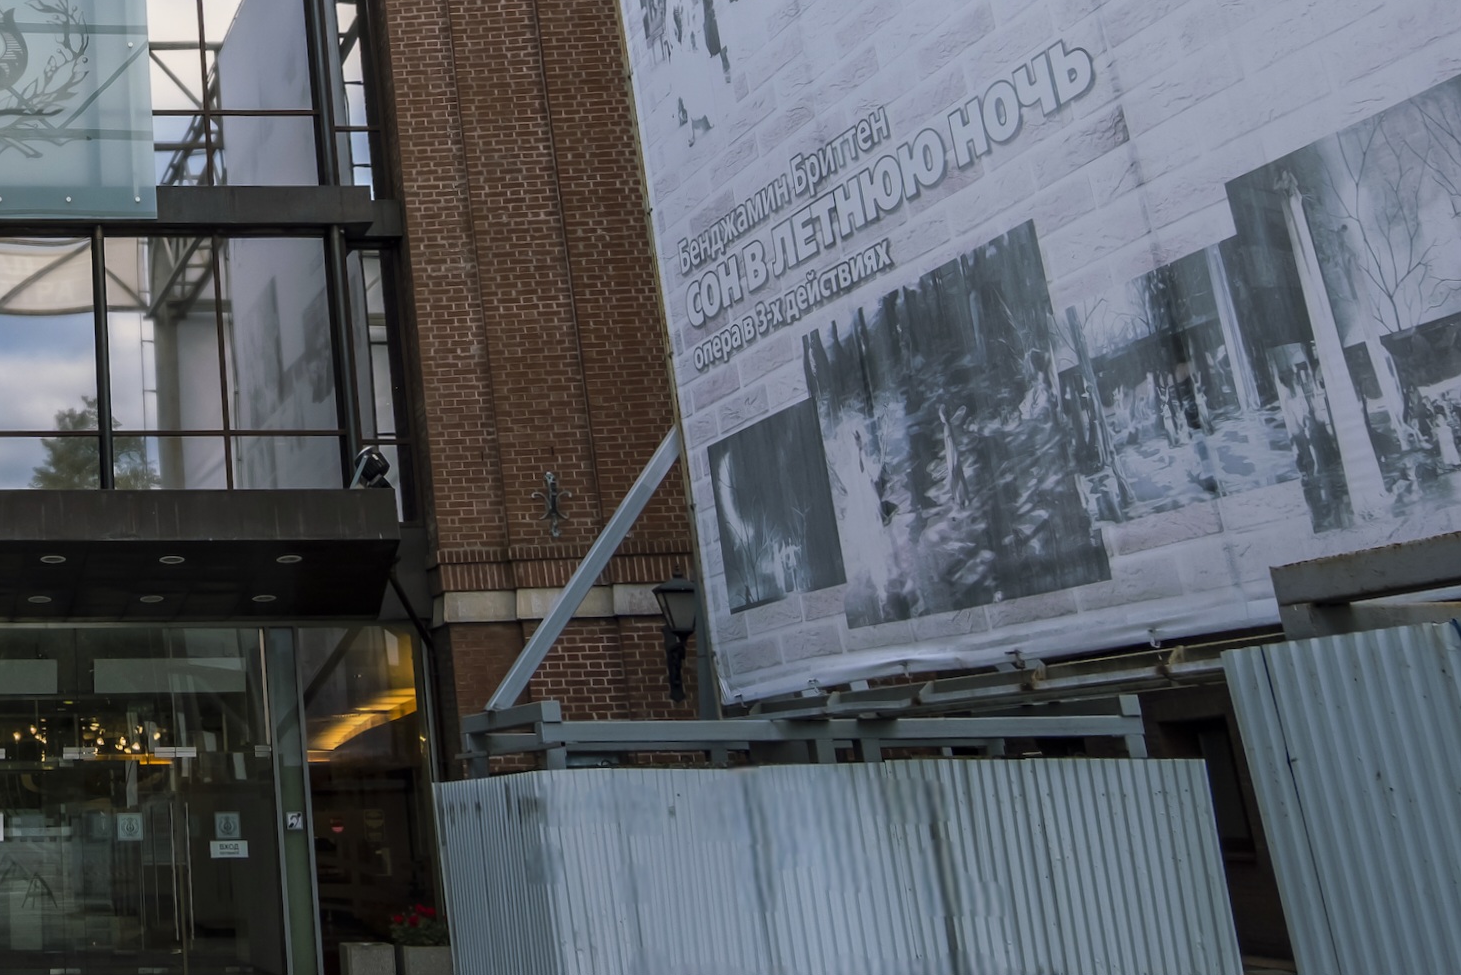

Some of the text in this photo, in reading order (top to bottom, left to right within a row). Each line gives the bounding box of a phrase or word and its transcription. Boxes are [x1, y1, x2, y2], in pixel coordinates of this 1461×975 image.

[677, 105, 890, 276] Бенджамин Бриттен
[686, 38, 1095, 328] СОН В ЛЕТНЮЮ НОЧЬ
[693, 237, 895, 371] опера в 3-х действиях
